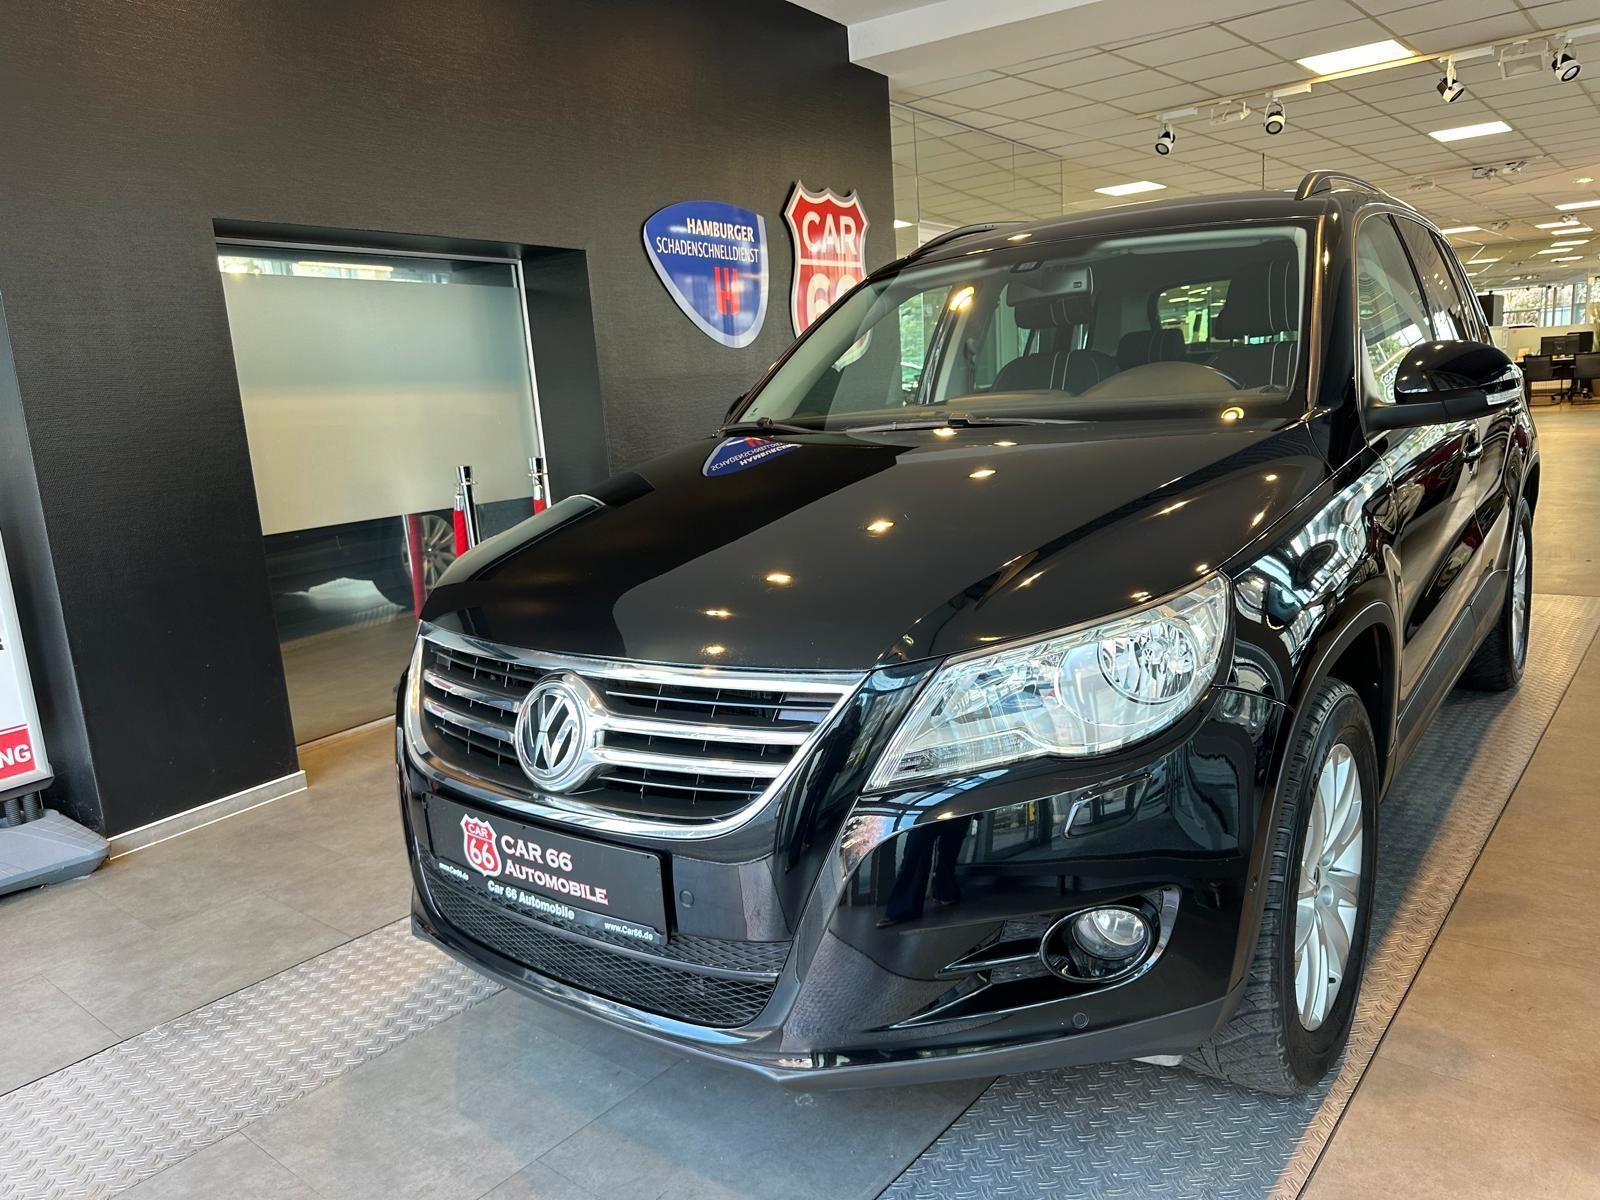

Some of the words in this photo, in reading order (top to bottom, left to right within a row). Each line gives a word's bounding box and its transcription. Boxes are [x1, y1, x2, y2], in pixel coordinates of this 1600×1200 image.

[686, 217, 754, 242] HAMBURGER
[802, 211, 858, 255] CAR
[656, 236, 759, 263] SCHADENSCHNELLDIENST
[467, 822, 489, 839] CAR
[469, 840, 496, 870] 66
[501, 835, 544, 864] CAR
[546, 848, 573, 872] 66
[504, 859, 609, 905] AUTOMOBILE
[487, 880, 505, 896] Car
[505, 886, 518, 900] 66
[518, 891, 576, 921] Automobile
[604, 921, 654, 941] www.Car66.de
